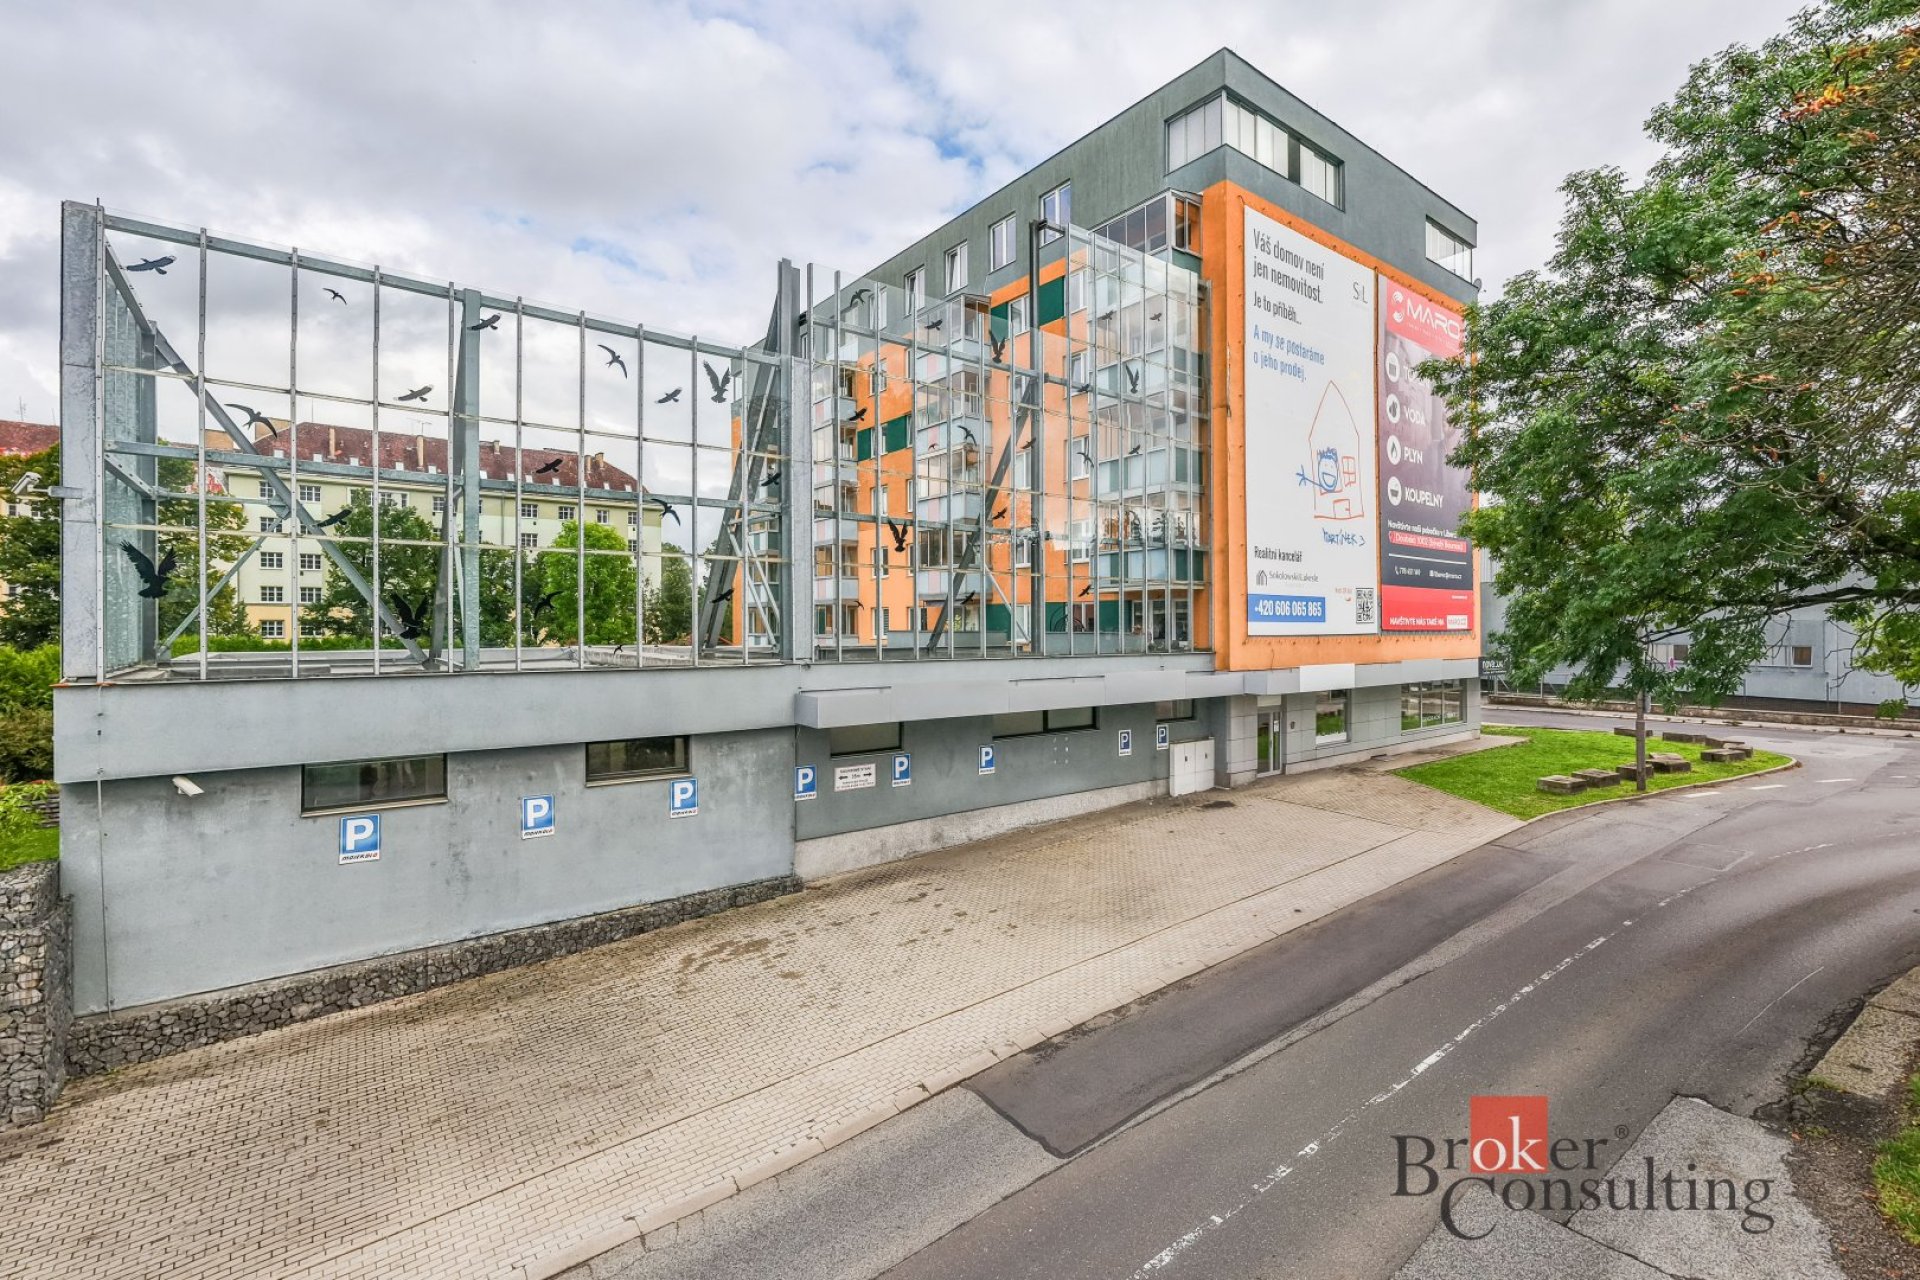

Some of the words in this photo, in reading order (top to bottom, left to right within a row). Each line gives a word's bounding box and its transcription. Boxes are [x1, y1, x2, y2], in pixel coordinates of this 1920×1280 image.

[1253, 228, 1271, 255] Váš
[1273, 240, 1304, 270] domov
[1305, 260, 1325, 281] není
[1253, 255, 1269, 280] jen
[1253, 290, 1262, 309] Je
[1263, 295, 1271, 313] to
[1253, 324, 1260, 340] A
[1261, 330, 1274, 349] my
[1275, 335, 1285, 351] se
[1286, 339, 1325, 366] postaráme
[1253, 351, 1259, 364] o
[1260, 350, 1279, 371] jeho
[1279, 361, 1307, 382] prodej.
[1403, 405, 1426, 426] VODA
[1403, 446, 1423, 464] PLYN
[1404, 486, 1444, 508] KOUPELNY
[1254, 546, 1277, 560] Realitní
[1278, 548, 1302, 562] kancelář
[1254, 599, 1274, 616] +420
[1275, 601, 1290, 616] 606
[1292, 601, 1307, 616] 065
[1308, 602, 1322, 617] 865
[1121, 733, 1129, 749] P
[1158, 728, 1166, 743] P
[895, 756, 909, 779] P
[981, 747, 993, 767] P
[797, 767, 814, 792] P
[674, 781, 694, 808] P
[527, 798, 549, 828] P
[345, 818, 374, 851] P
